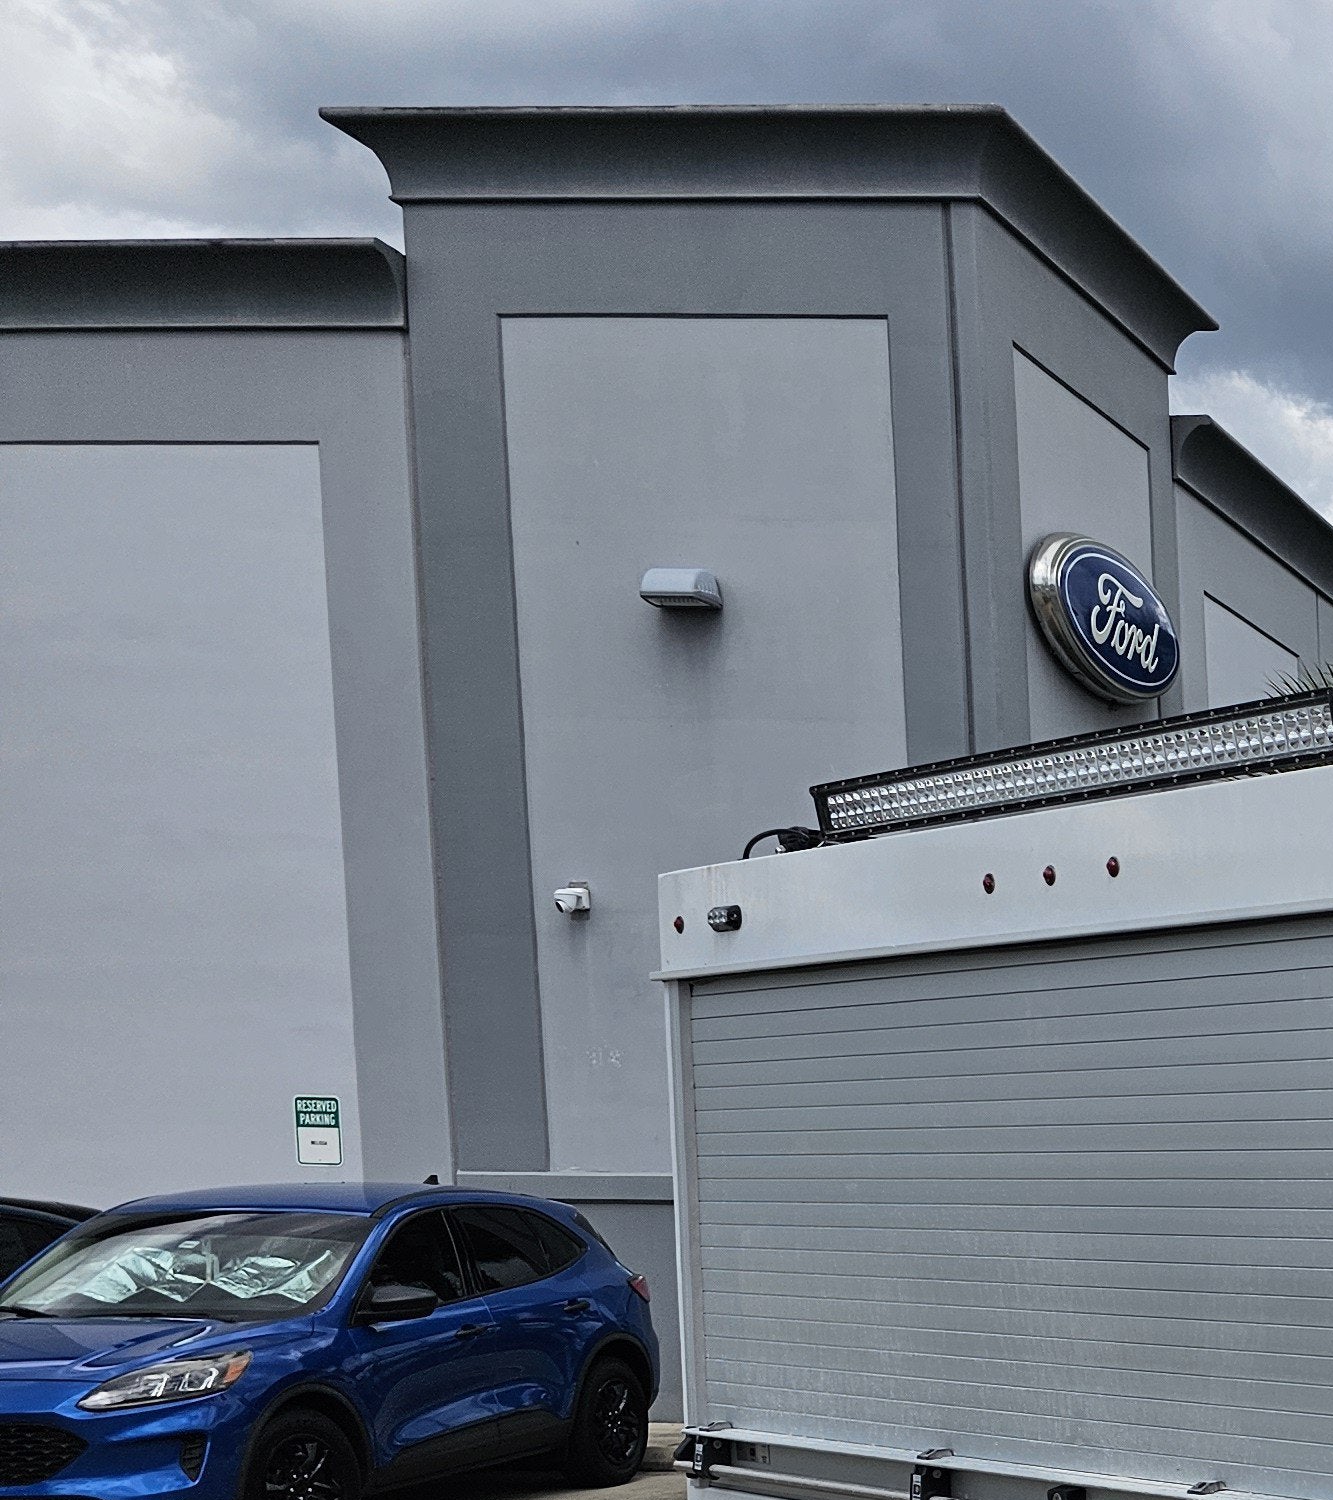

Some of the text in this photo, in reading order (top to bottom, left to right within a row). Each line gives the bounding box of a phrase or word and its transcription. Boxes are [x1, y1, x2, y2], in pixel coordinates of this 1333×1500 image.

[1091, 573, 1160, 673] Ford
[296, 1100, 337, 1112] RESERVED
[300, 1113, 336, 1126] PARKING
